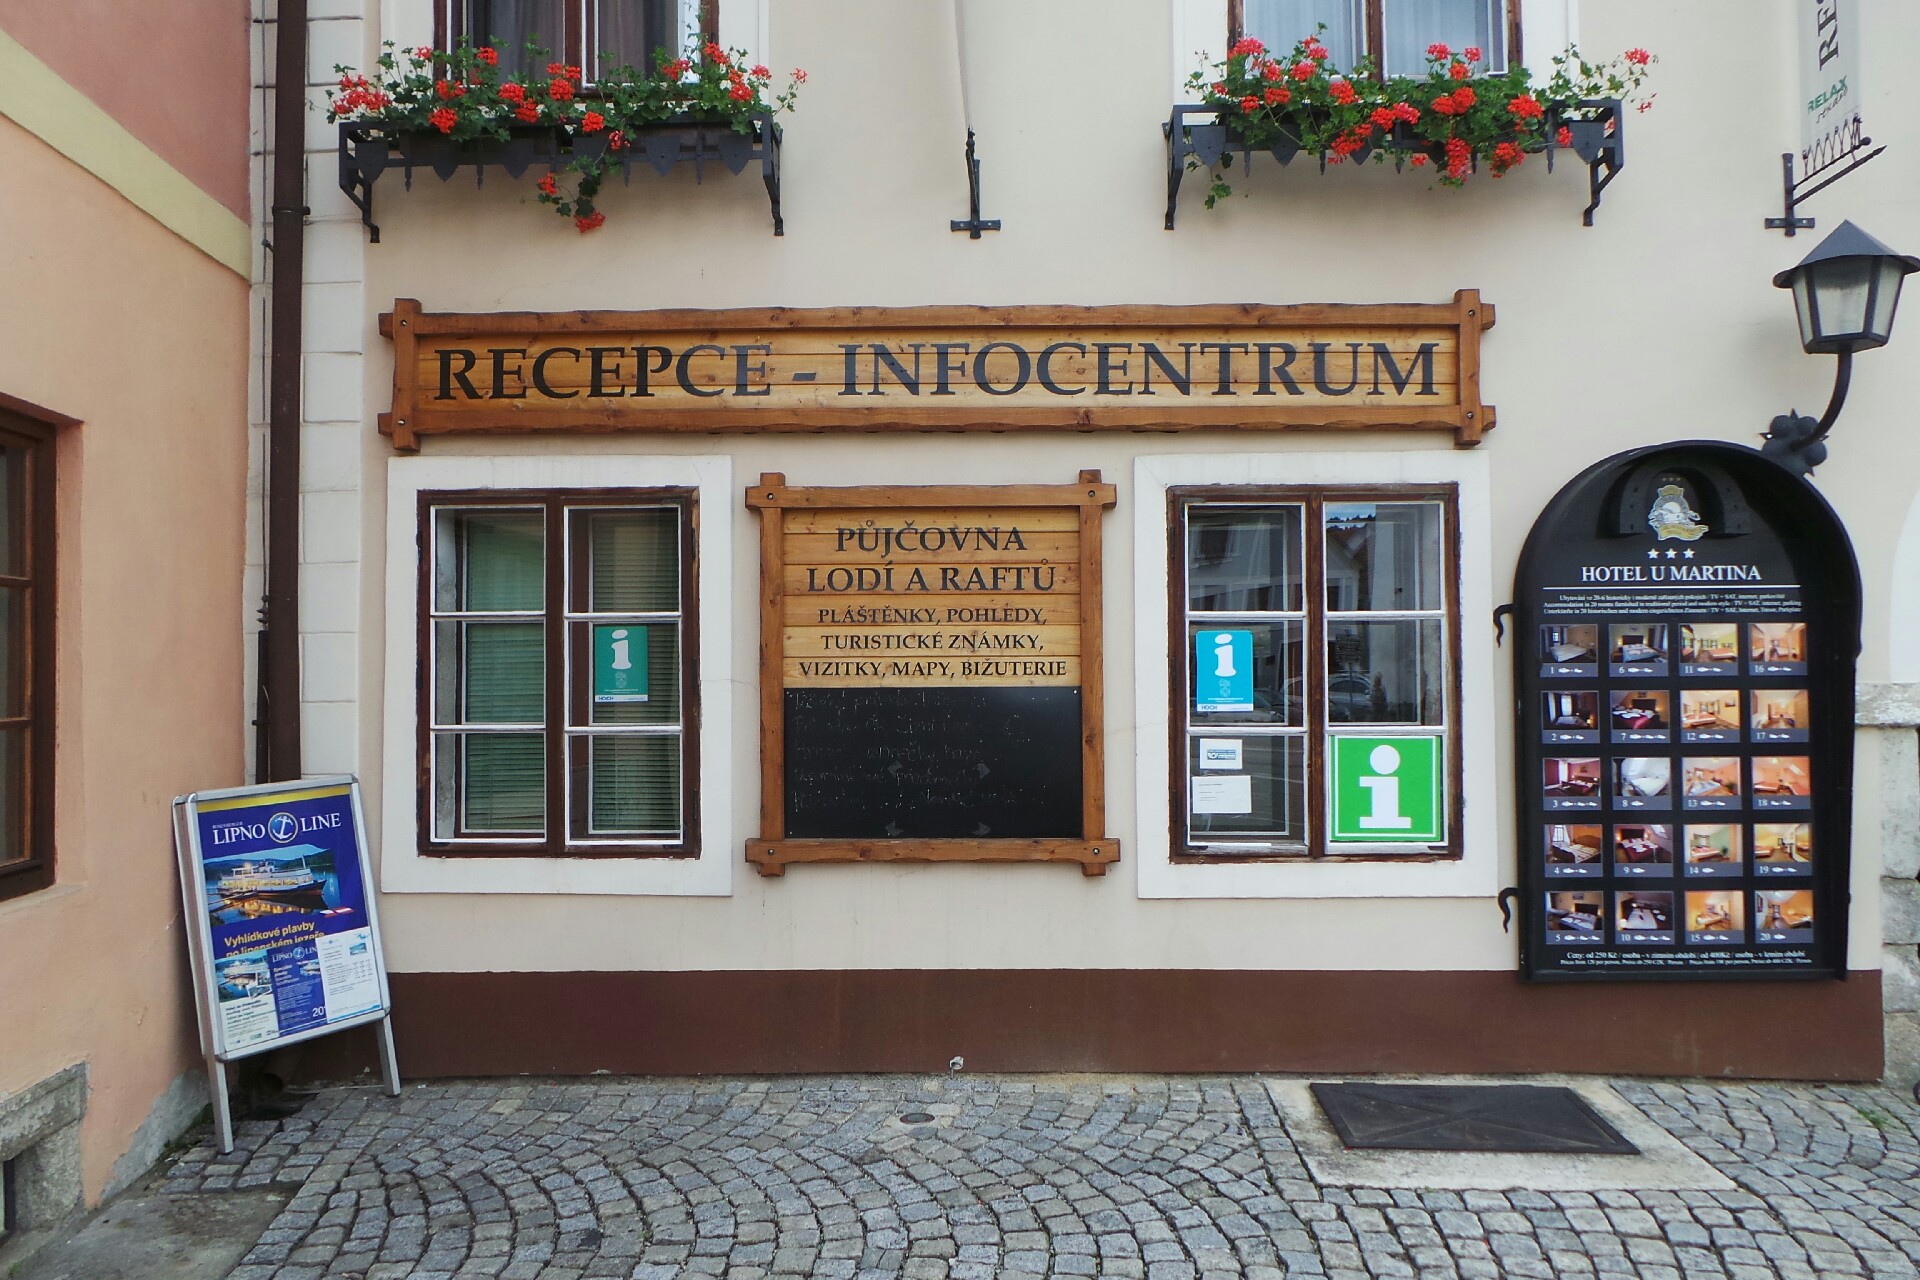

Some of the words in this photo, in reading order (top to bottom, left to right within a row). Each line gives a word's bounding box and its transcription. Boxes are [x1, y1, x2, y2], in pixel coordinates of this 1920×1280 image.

[1816, 0, 1838, 71] RE
[1808, 75, 1847, 114] RELAX
[434, 344, 771, 400] RECEPCE
[792, 372, 817, 382] -
[838, 342, 1440, 397] INFOCENTRUM
[835, 520, 1028, 558] PŮJČOVNA
[807, 560, 894, 592] LODÍ
[905, 567, 930, 591] A
[940, 559, 1056, 591] RAFTŮ
[1581, 566, 1647, 582] HOTEL
[1651, 566, 1665, 581] U
[1670, 565, 1762, 581] MARTINA
[818, 606, 941, 625] PLÁŠTĚNKY,
[946, 608, 1047, 625] POHLEDY,
[821, 632, 943, 650] TURISTICKÉ
[949, 632, 1044, 651] ZNÁMKY,
[800, 662, 886, 678] VIZITKY,
[892, 662, 954, 678] MAPY,
[962, 658, 1066, 676] BIŽUTERIE
[213, 824, 266, 844] LIPNO
[300, 813, 341, 832] LINE
[224, 927, 280, 947] Vyhlídkové
[282, 922, 315, 936] plavby
[272, 952, 292, 962] LIPNO
[305, 946, 318, 955] LIN
